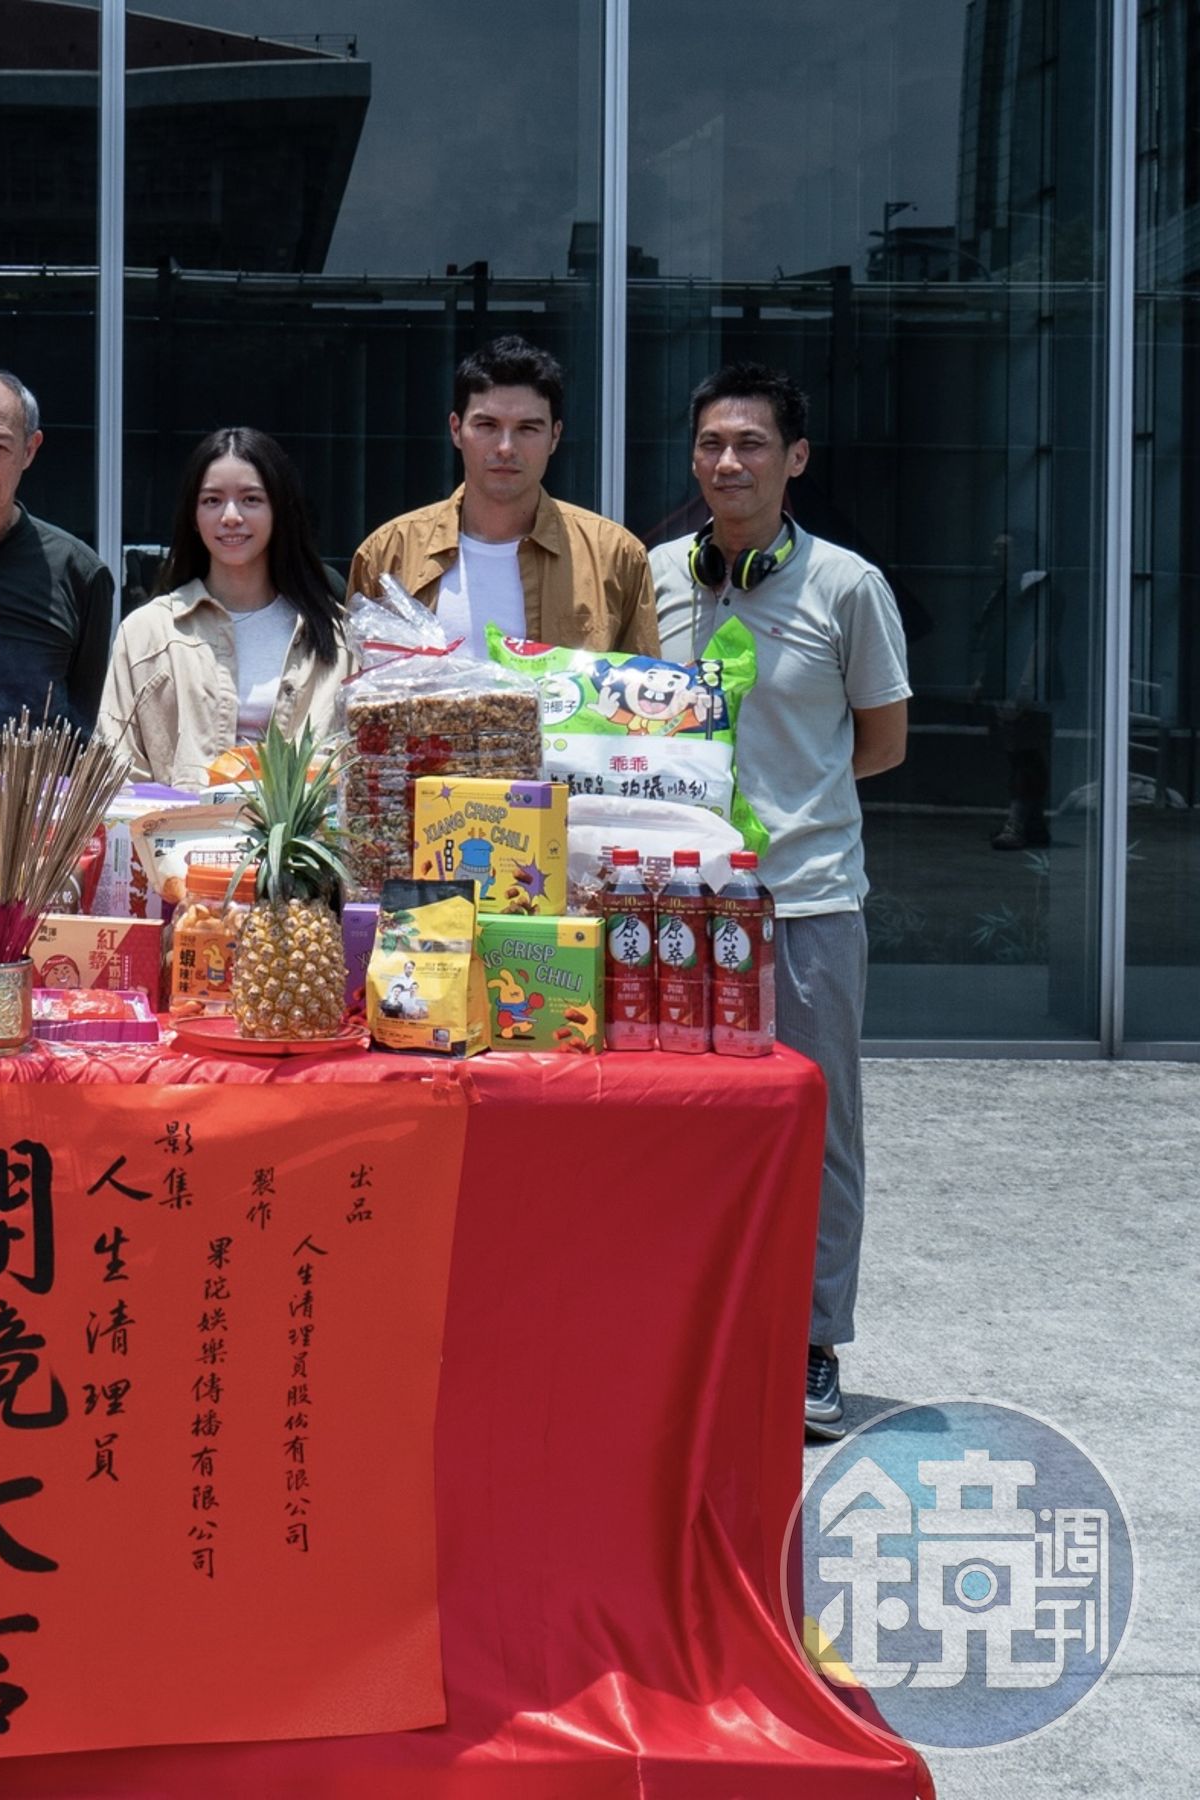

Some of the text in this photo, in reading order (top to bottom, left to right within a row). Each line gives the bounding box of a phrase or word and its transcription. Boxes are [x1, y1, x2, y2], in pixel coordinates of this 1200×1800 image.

[609, 755, 648, 772] 乖乖
[423, 800, 529, 853] XIANG CRISP CHILI
[502, 938, 556, 963] CRISP
[535, 963, 583, 993] CHILI
[616, 915, 641, 967] 原萃
[661, 917, 685, 970] 原萃
[716, 919, 741, 972] 原萃
[83, 1120, 194, 1482] 影集 人生清理員
[187, 1166, 276, 1579] 製作 果陀娛樂傳播有限公司
[283, 1164, 373, 1553] 出品 人生清理員股份有限公司
